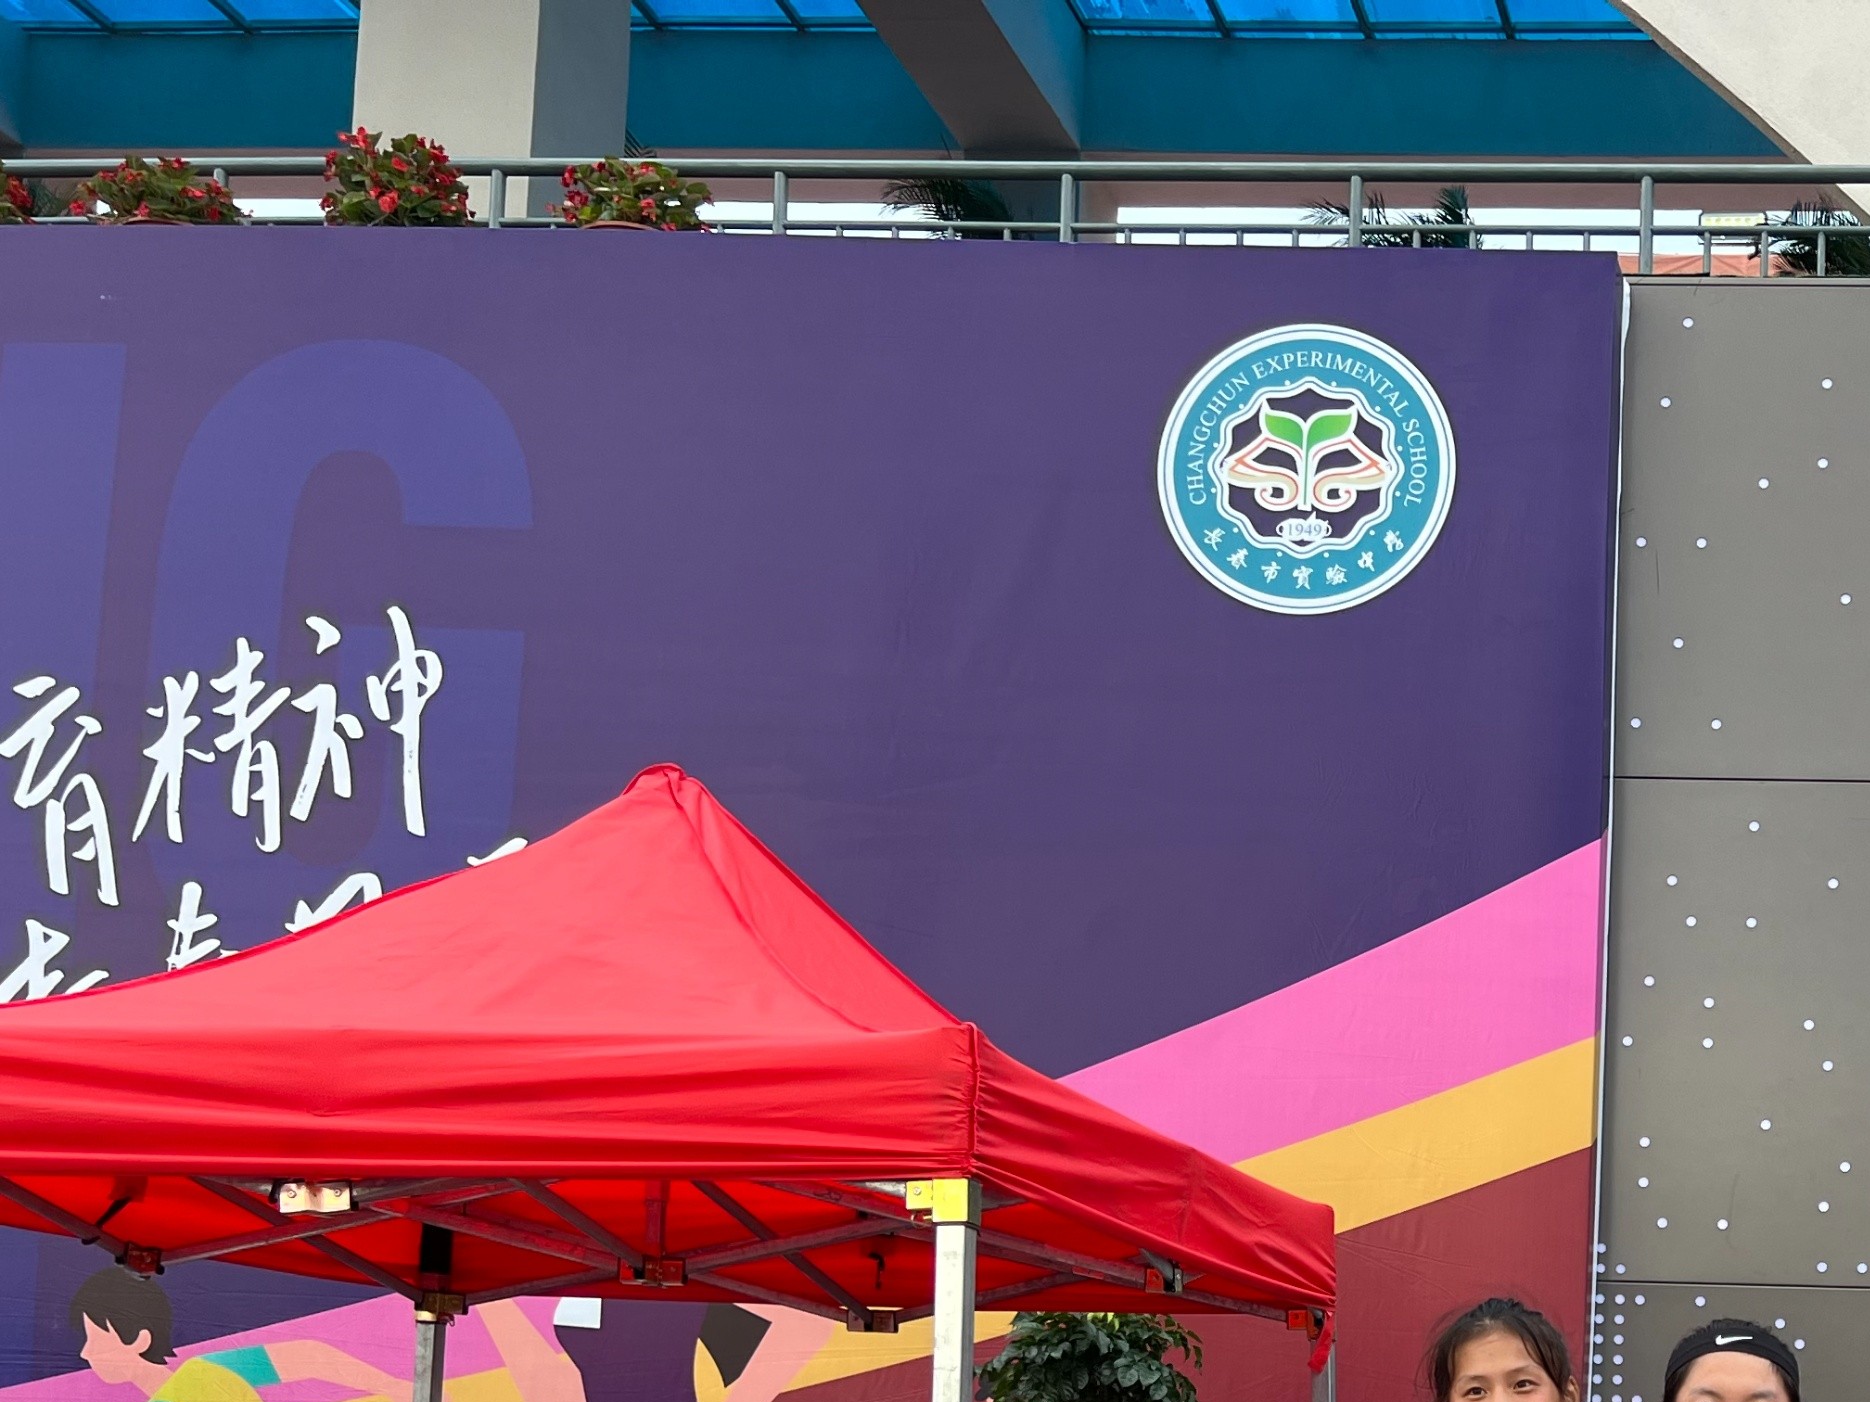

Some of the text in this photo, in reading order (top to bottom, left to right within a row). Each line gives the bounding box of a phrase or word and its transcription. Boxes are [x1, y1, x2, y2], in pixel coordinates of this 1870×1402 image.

[1188, 351, 1428, 508] CHANGCHUN EXPERIMENTAL SCHOOL
[1287, 523, 1322, 537] 1949
